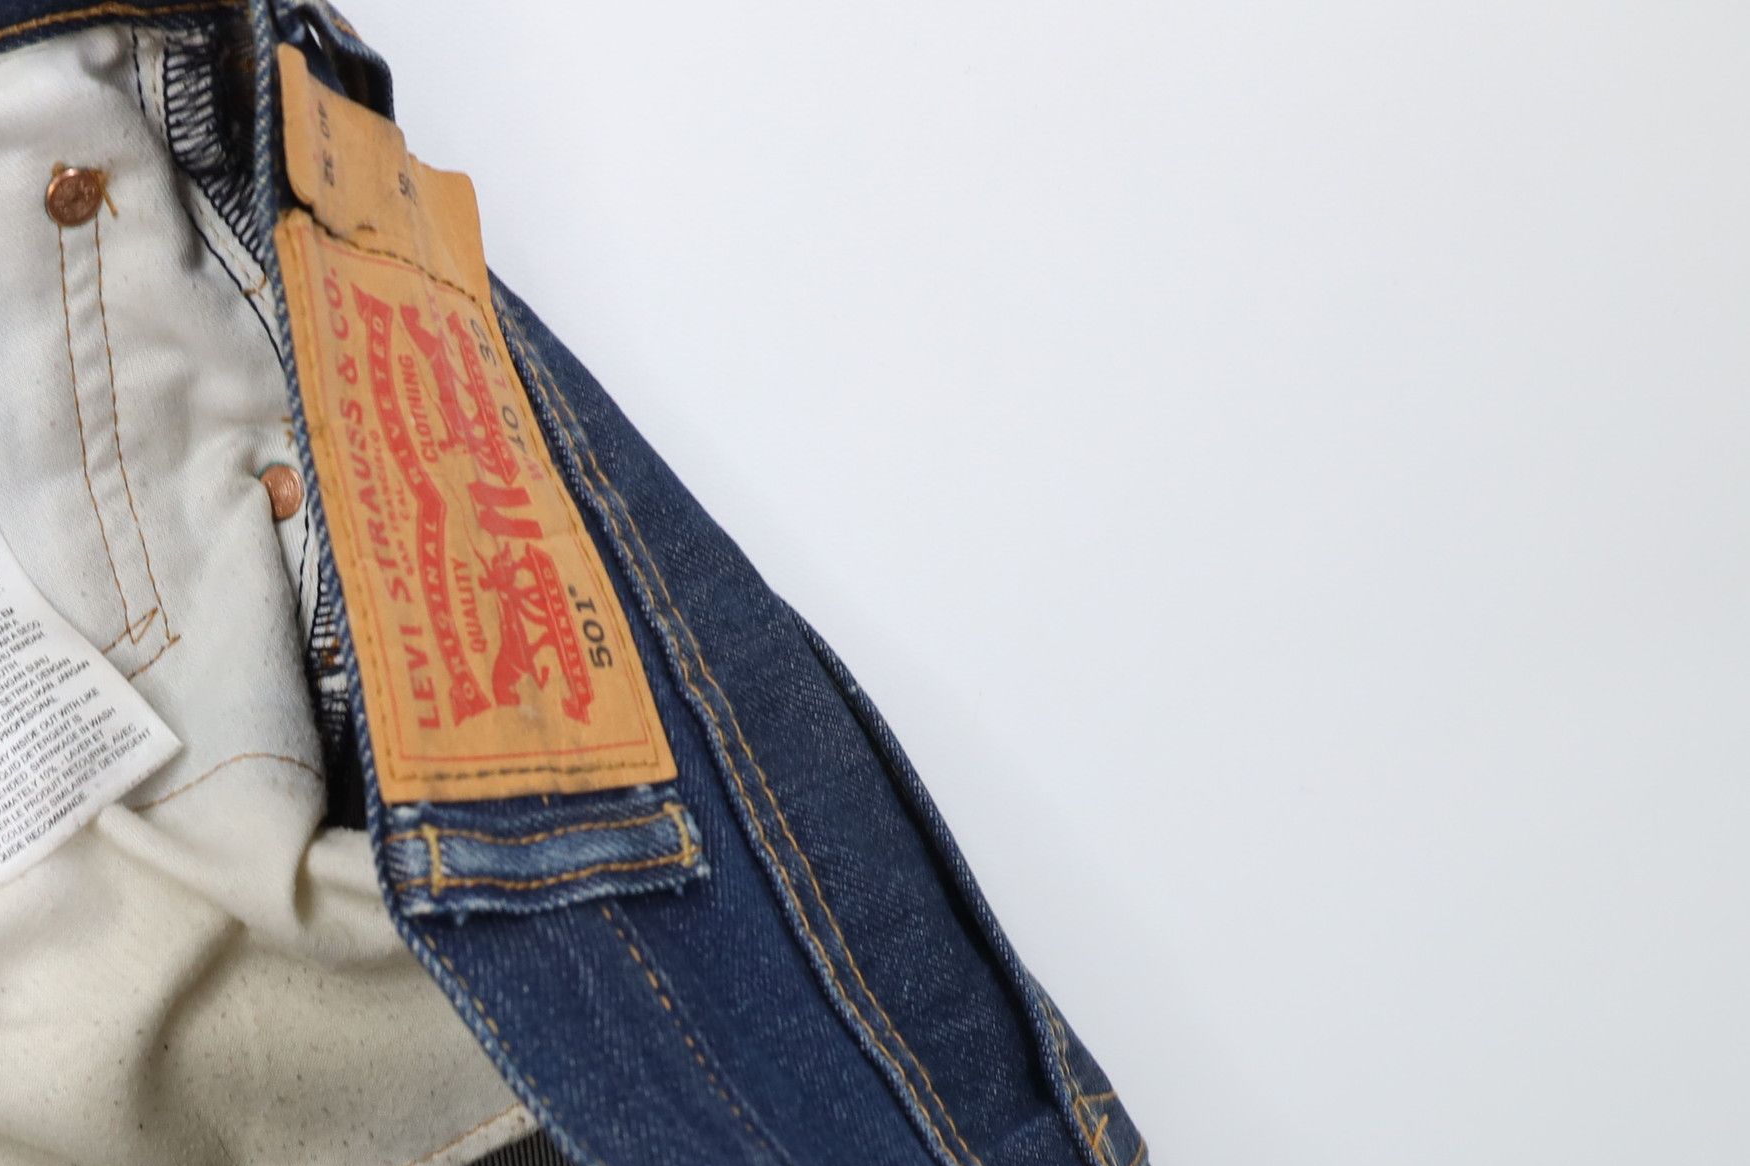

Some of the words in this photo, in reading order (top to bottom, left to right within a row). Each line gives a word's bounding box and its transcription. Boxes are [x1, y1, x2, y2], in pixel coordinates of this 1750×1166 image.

[321, 265, 351, 341] CO.
[335, 351, 359, 386] &
[372, 315, 424, 484] RIVETED
[397, 352, 439, 463] CLOTHING
[337, 397, 413, 605] STRAUSS
[425, 520, 474, 701] ORIGINAL
[451, 555, 488, 654] QUALITY
[542, 563, 586, 694] PATENTED
[8, 728, 41, 756] INSIDE
[39, 712, 61, 734] OUT
[58, 699, 81, 720] WITH
[79, 685, 100, 706] LIKE
[397, 623, 441, 731] LEVI
